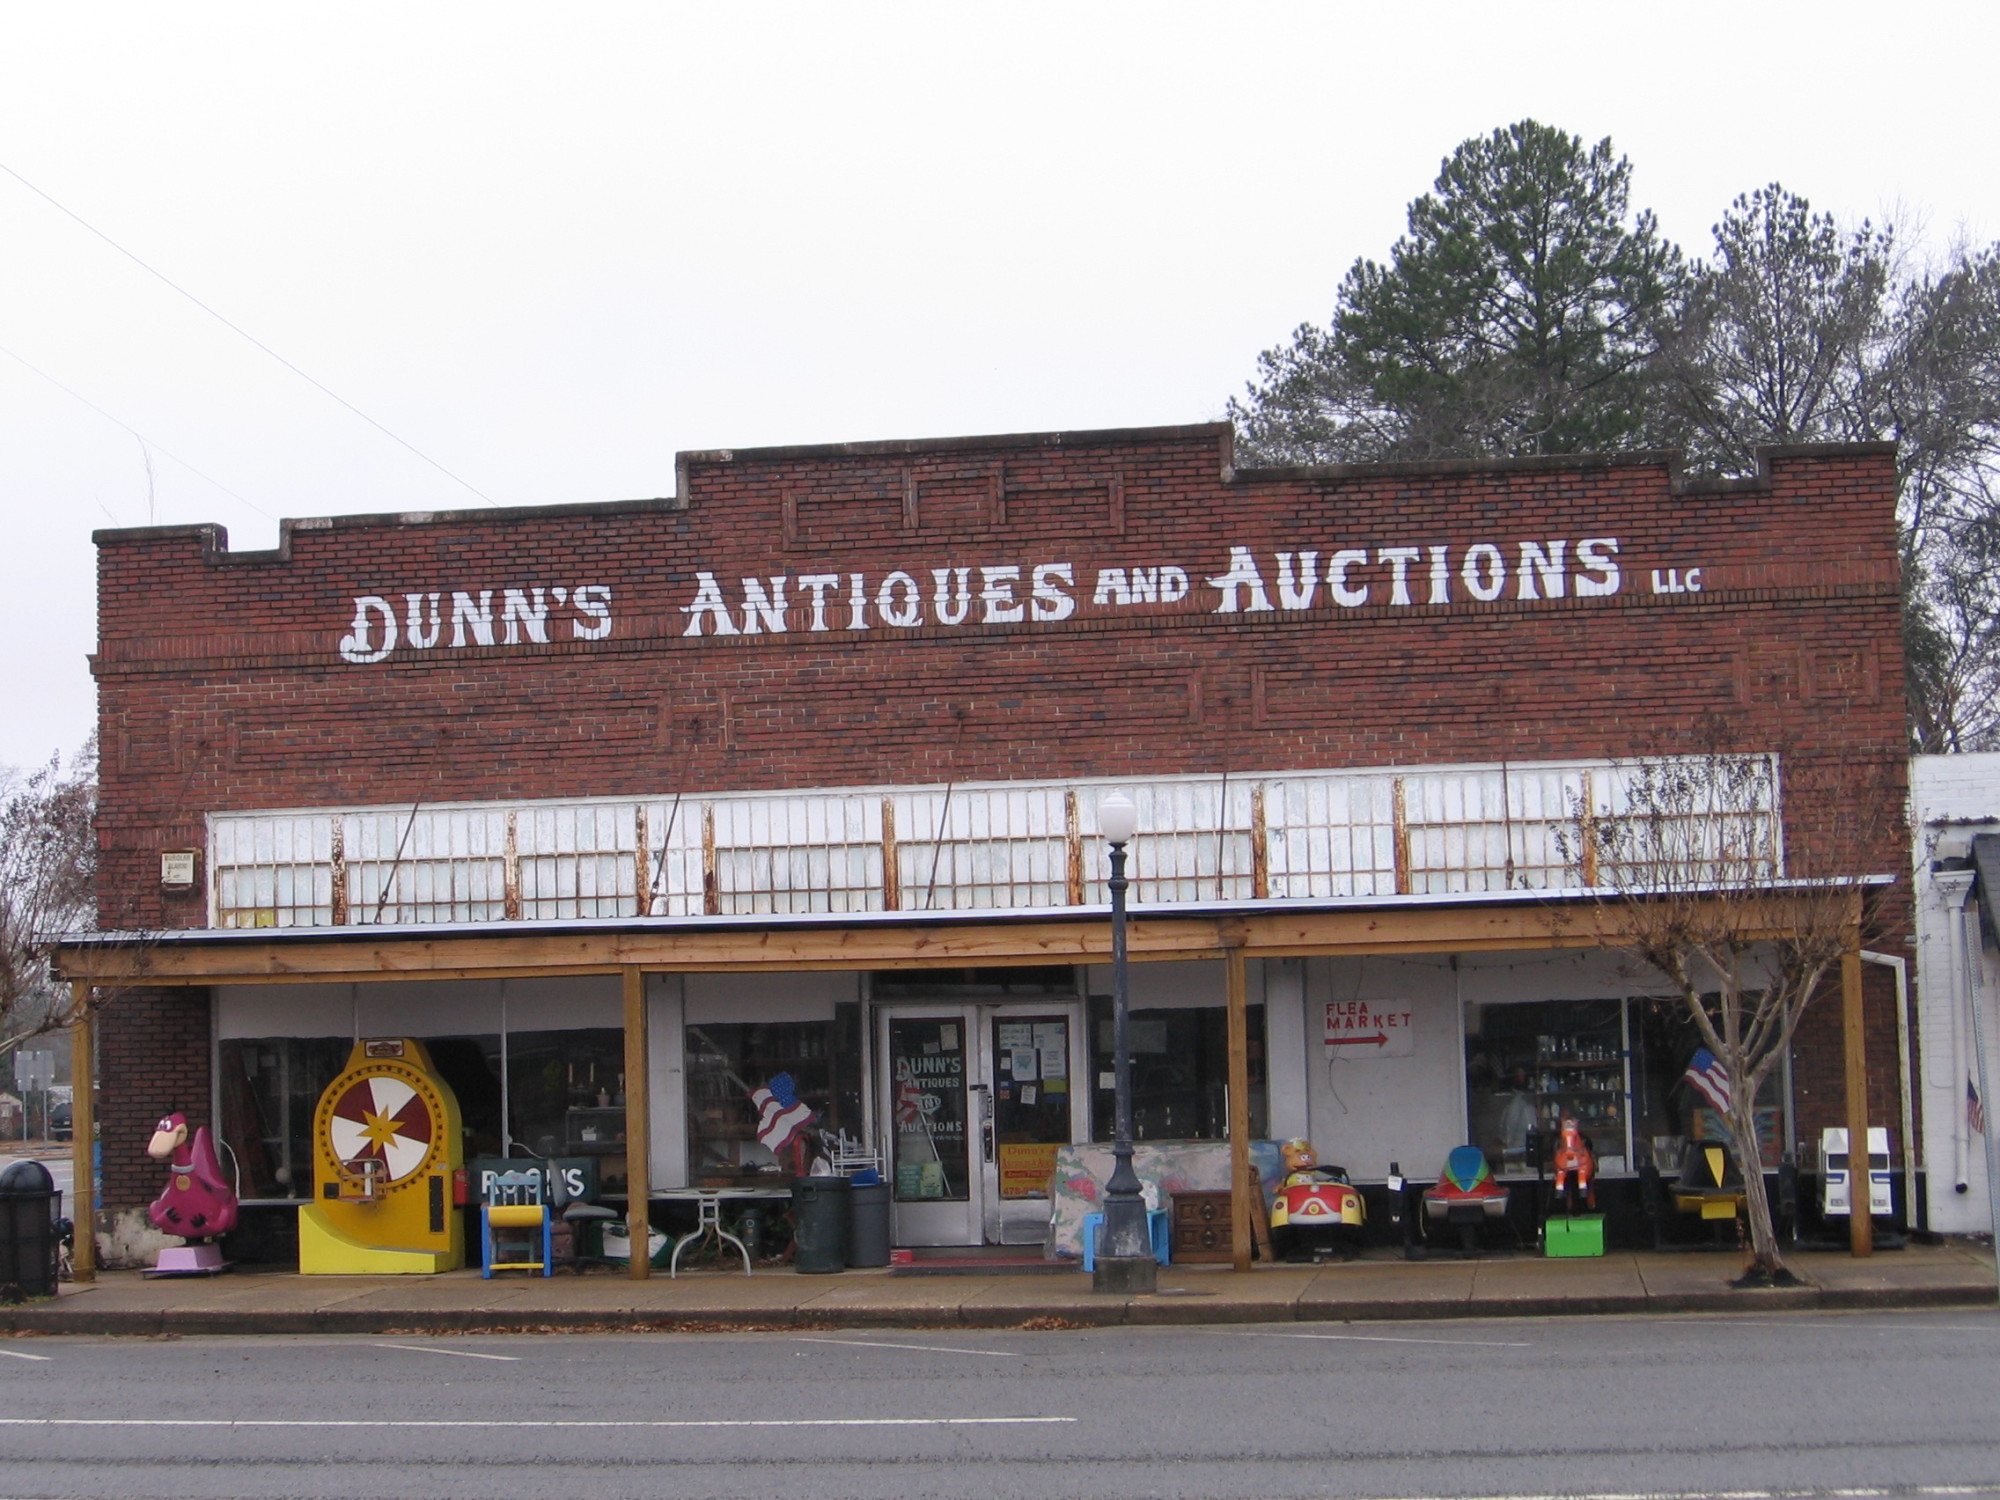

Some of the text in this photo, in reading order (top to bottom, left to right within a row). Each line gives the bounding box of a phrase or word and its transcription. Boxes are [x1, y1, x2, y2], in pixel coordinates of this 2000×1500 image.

[339, 537, 1701, 665] DUNN'S ANTIQUES AND AUCTIONS LLC
[1326, 1002, 1368, 1015] FLEA
[1326, 1013, 1411, 1028] MARKET
[896, 1057, 962, 1082] DUNN'S
[903, 1077, 960, 1089] ANTIQUES
[898, 1120, 964, 1133] AUCTIONS
